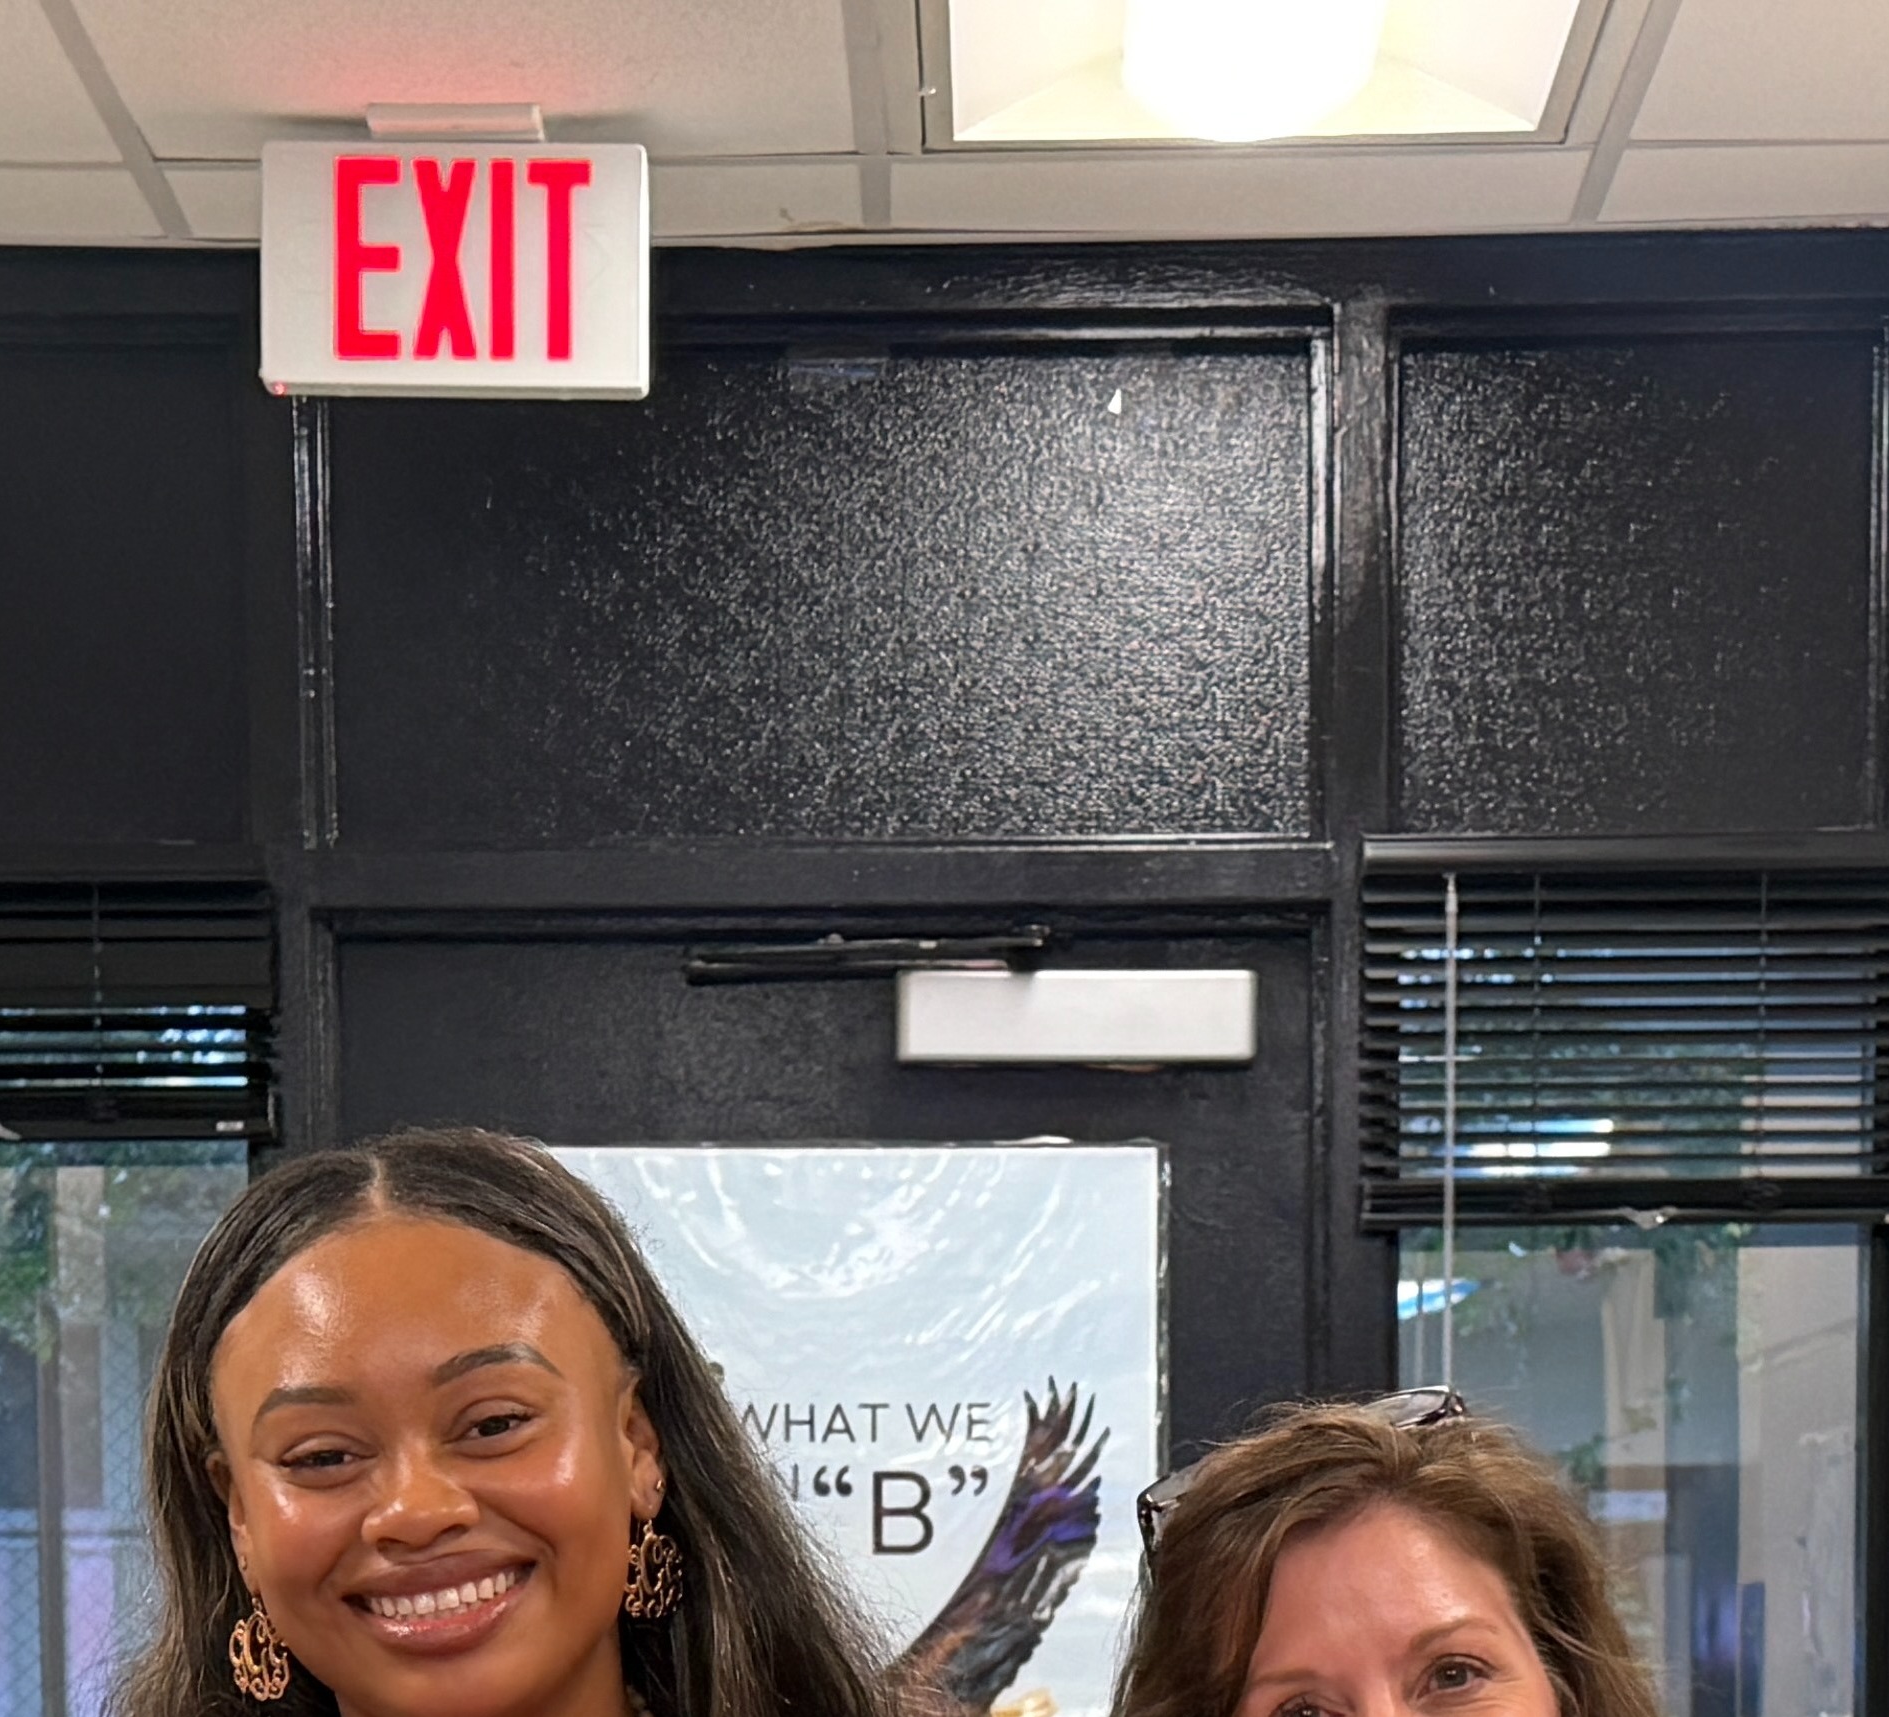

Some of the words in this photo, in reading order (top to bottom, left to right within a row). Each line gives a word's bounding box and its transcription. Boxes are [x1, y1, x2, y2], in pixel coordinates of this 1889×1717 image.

[333, 155, 593, 362] EXIT
[741, 1402, 890, 1443] WHAT
[906, 1402, 991, 1443] WE
